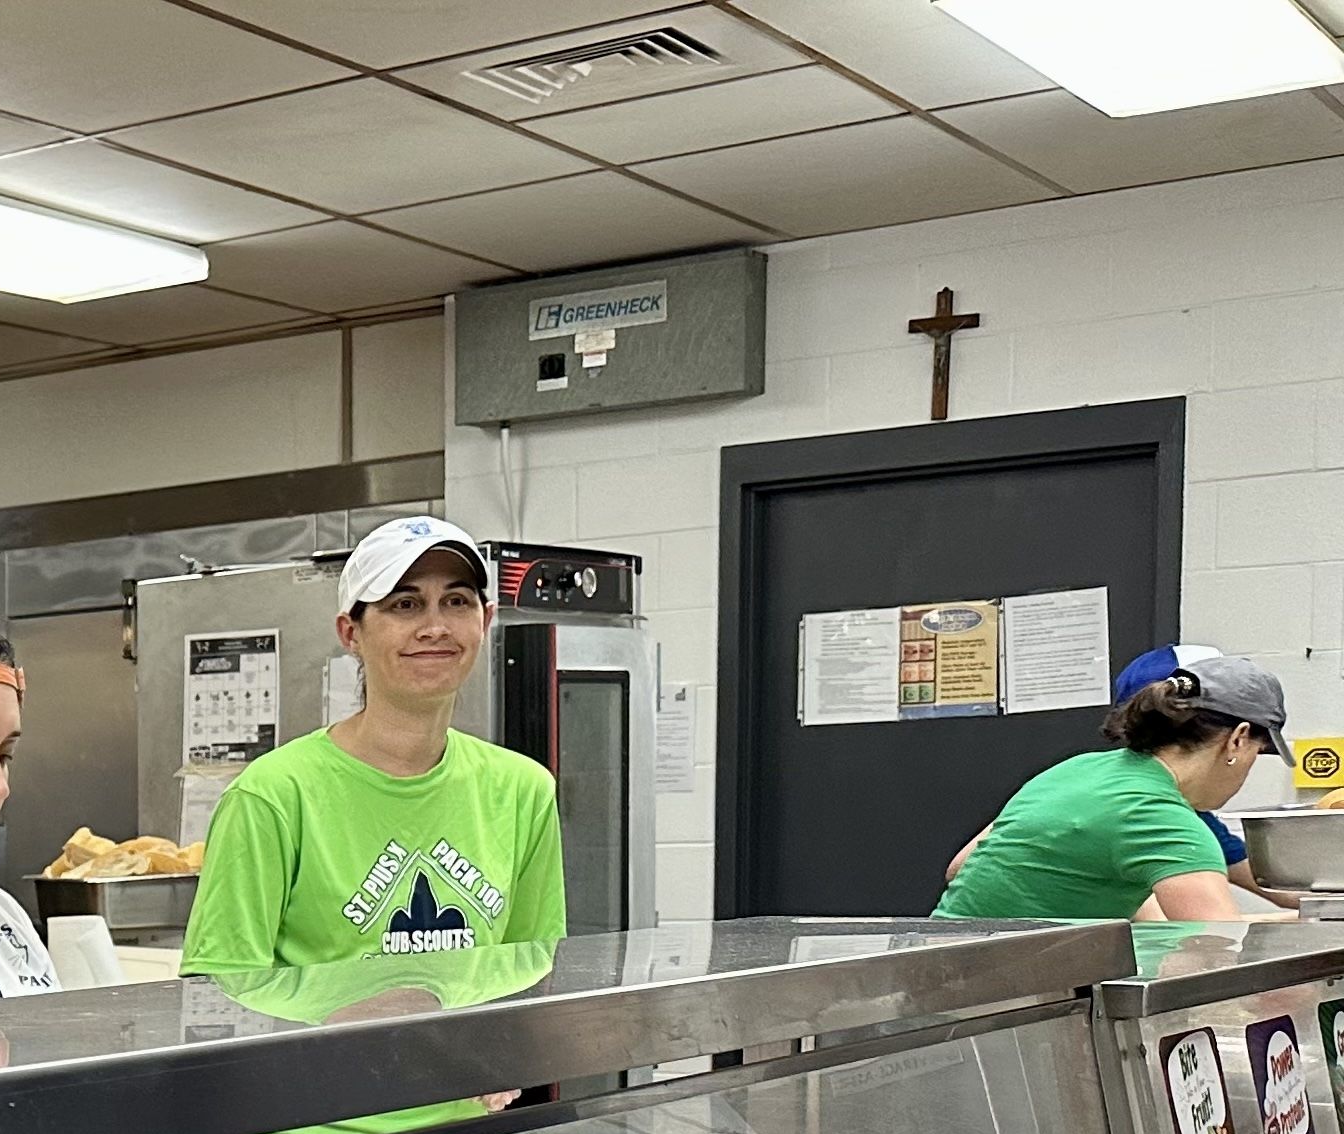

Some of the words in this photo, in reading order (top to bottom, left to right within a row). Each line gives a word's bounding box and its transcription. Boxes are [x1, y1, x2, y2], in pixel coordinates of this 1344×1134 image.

[563, 294, 662, 324] GREENHECK
[1306, 758, 1336, 768] STOP
[342, 891, 376, 926] ST.
[361, 853, 400, 902] PIUS
[385, 838, 409, 863] X
[429, 837, 484, 892] PACK
[475, 879, 505, 919] 100
[382, 930, 410, 954] CUB
[411, 926, 475, 953] SCOUTS
[1178, 1042, 1198, 1081] Bite
